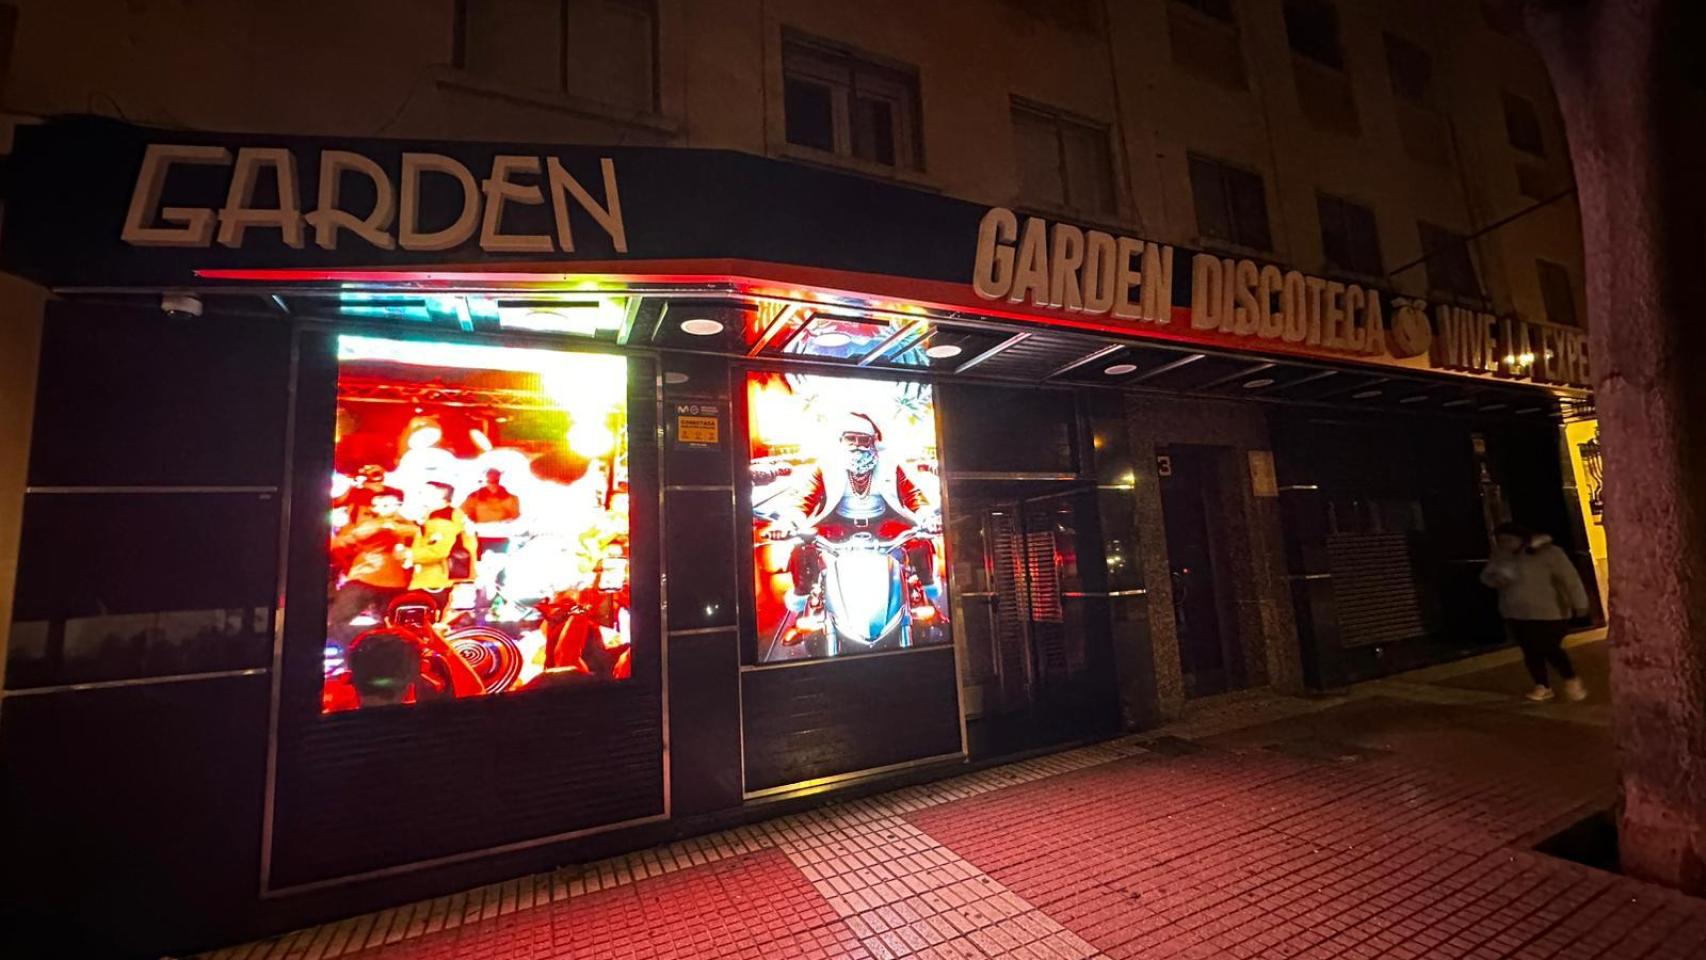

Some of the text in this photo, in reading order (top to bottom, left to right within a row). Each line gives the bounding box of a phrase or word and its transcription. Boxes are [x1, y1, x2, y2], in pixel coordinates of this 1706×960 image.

[121, 144, 629, 253] GARDEN
[973, 207, 1174, 325] GARDEN
[1191, 252, 1386, 356] DISCOTECA
[1440, 304, 1499, 372] VIVE
[1504, 318, 1535, 378] LA
[1157, 455, 1170, 476] 3
